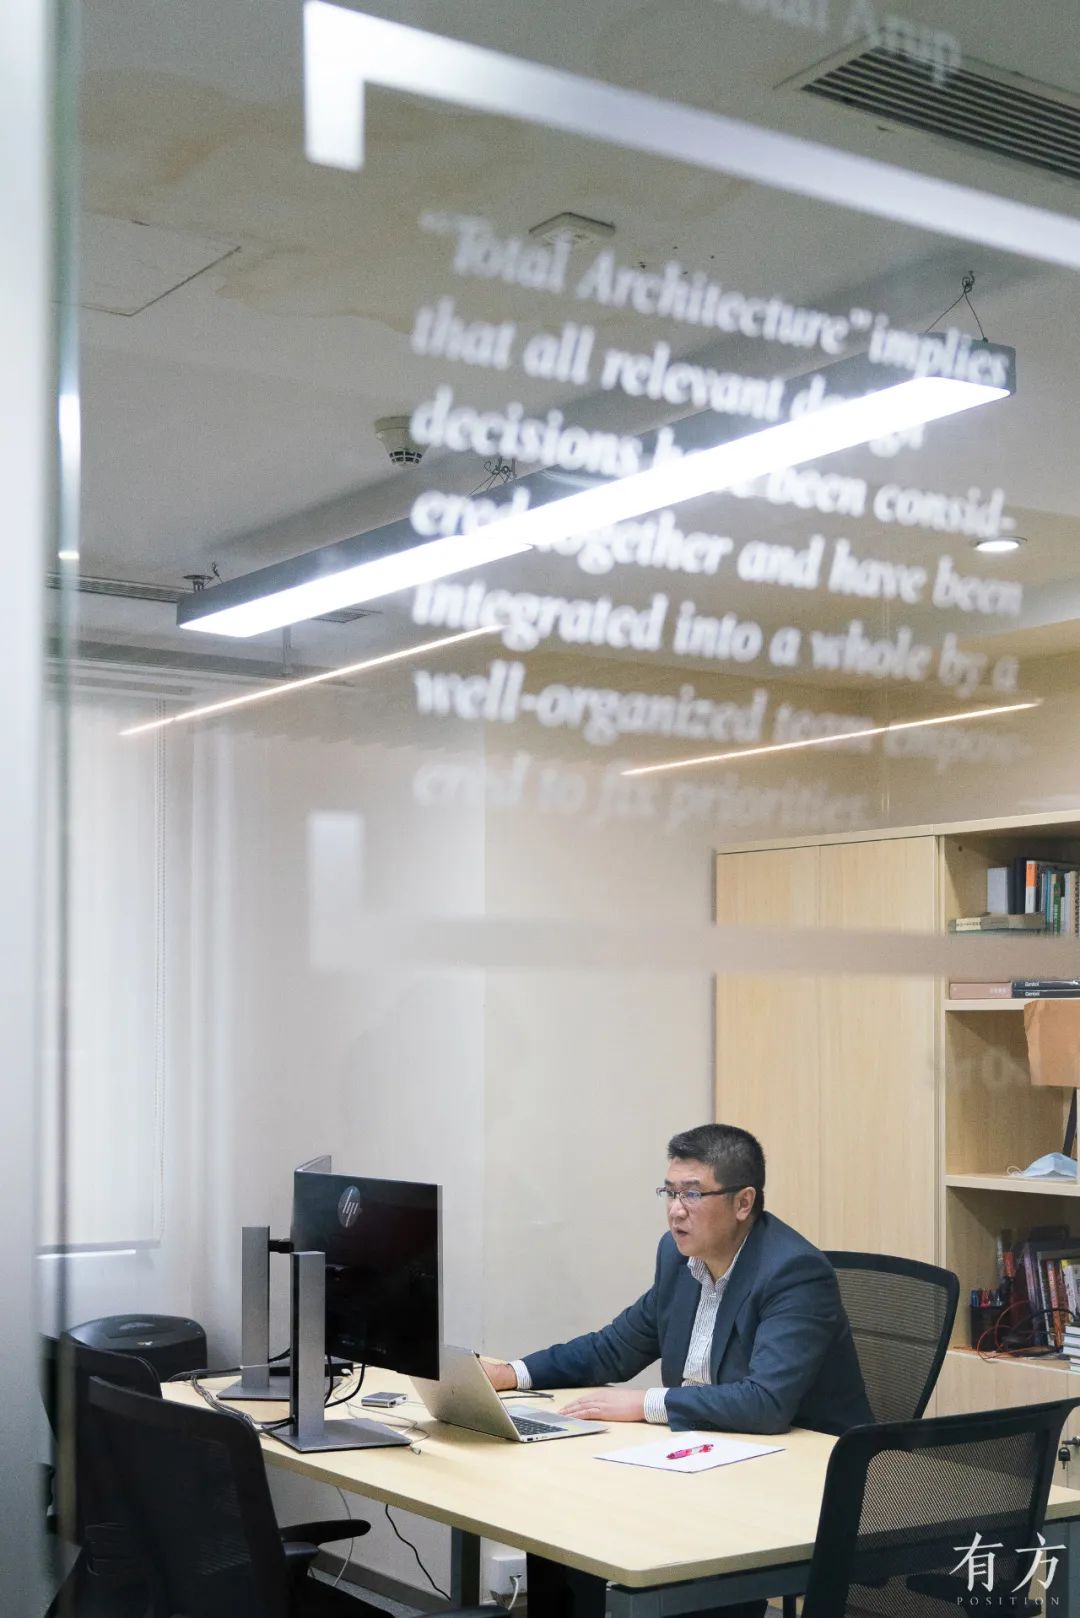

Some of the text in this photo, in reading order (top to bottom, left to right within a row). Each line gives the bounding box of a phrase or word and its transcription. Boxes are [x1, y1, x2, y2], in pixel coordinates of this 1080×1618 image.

[411, 297, 517, 371] that
[523, 320, 596, 386] all
[601, 341, 786, 422] relevant
[868, 313, 1010, 387] implies
[409, 384, 643, 477] decisions
[766, 468, 1017, 537] been consid-
[738, 535, 825, 590] and
[828, 538, 927, 604] have
[933, 556, 1023, 617] been
[411, 578, 1019, 698] integrated into a whole by a
[413, 658, 769, 744] well-organized
